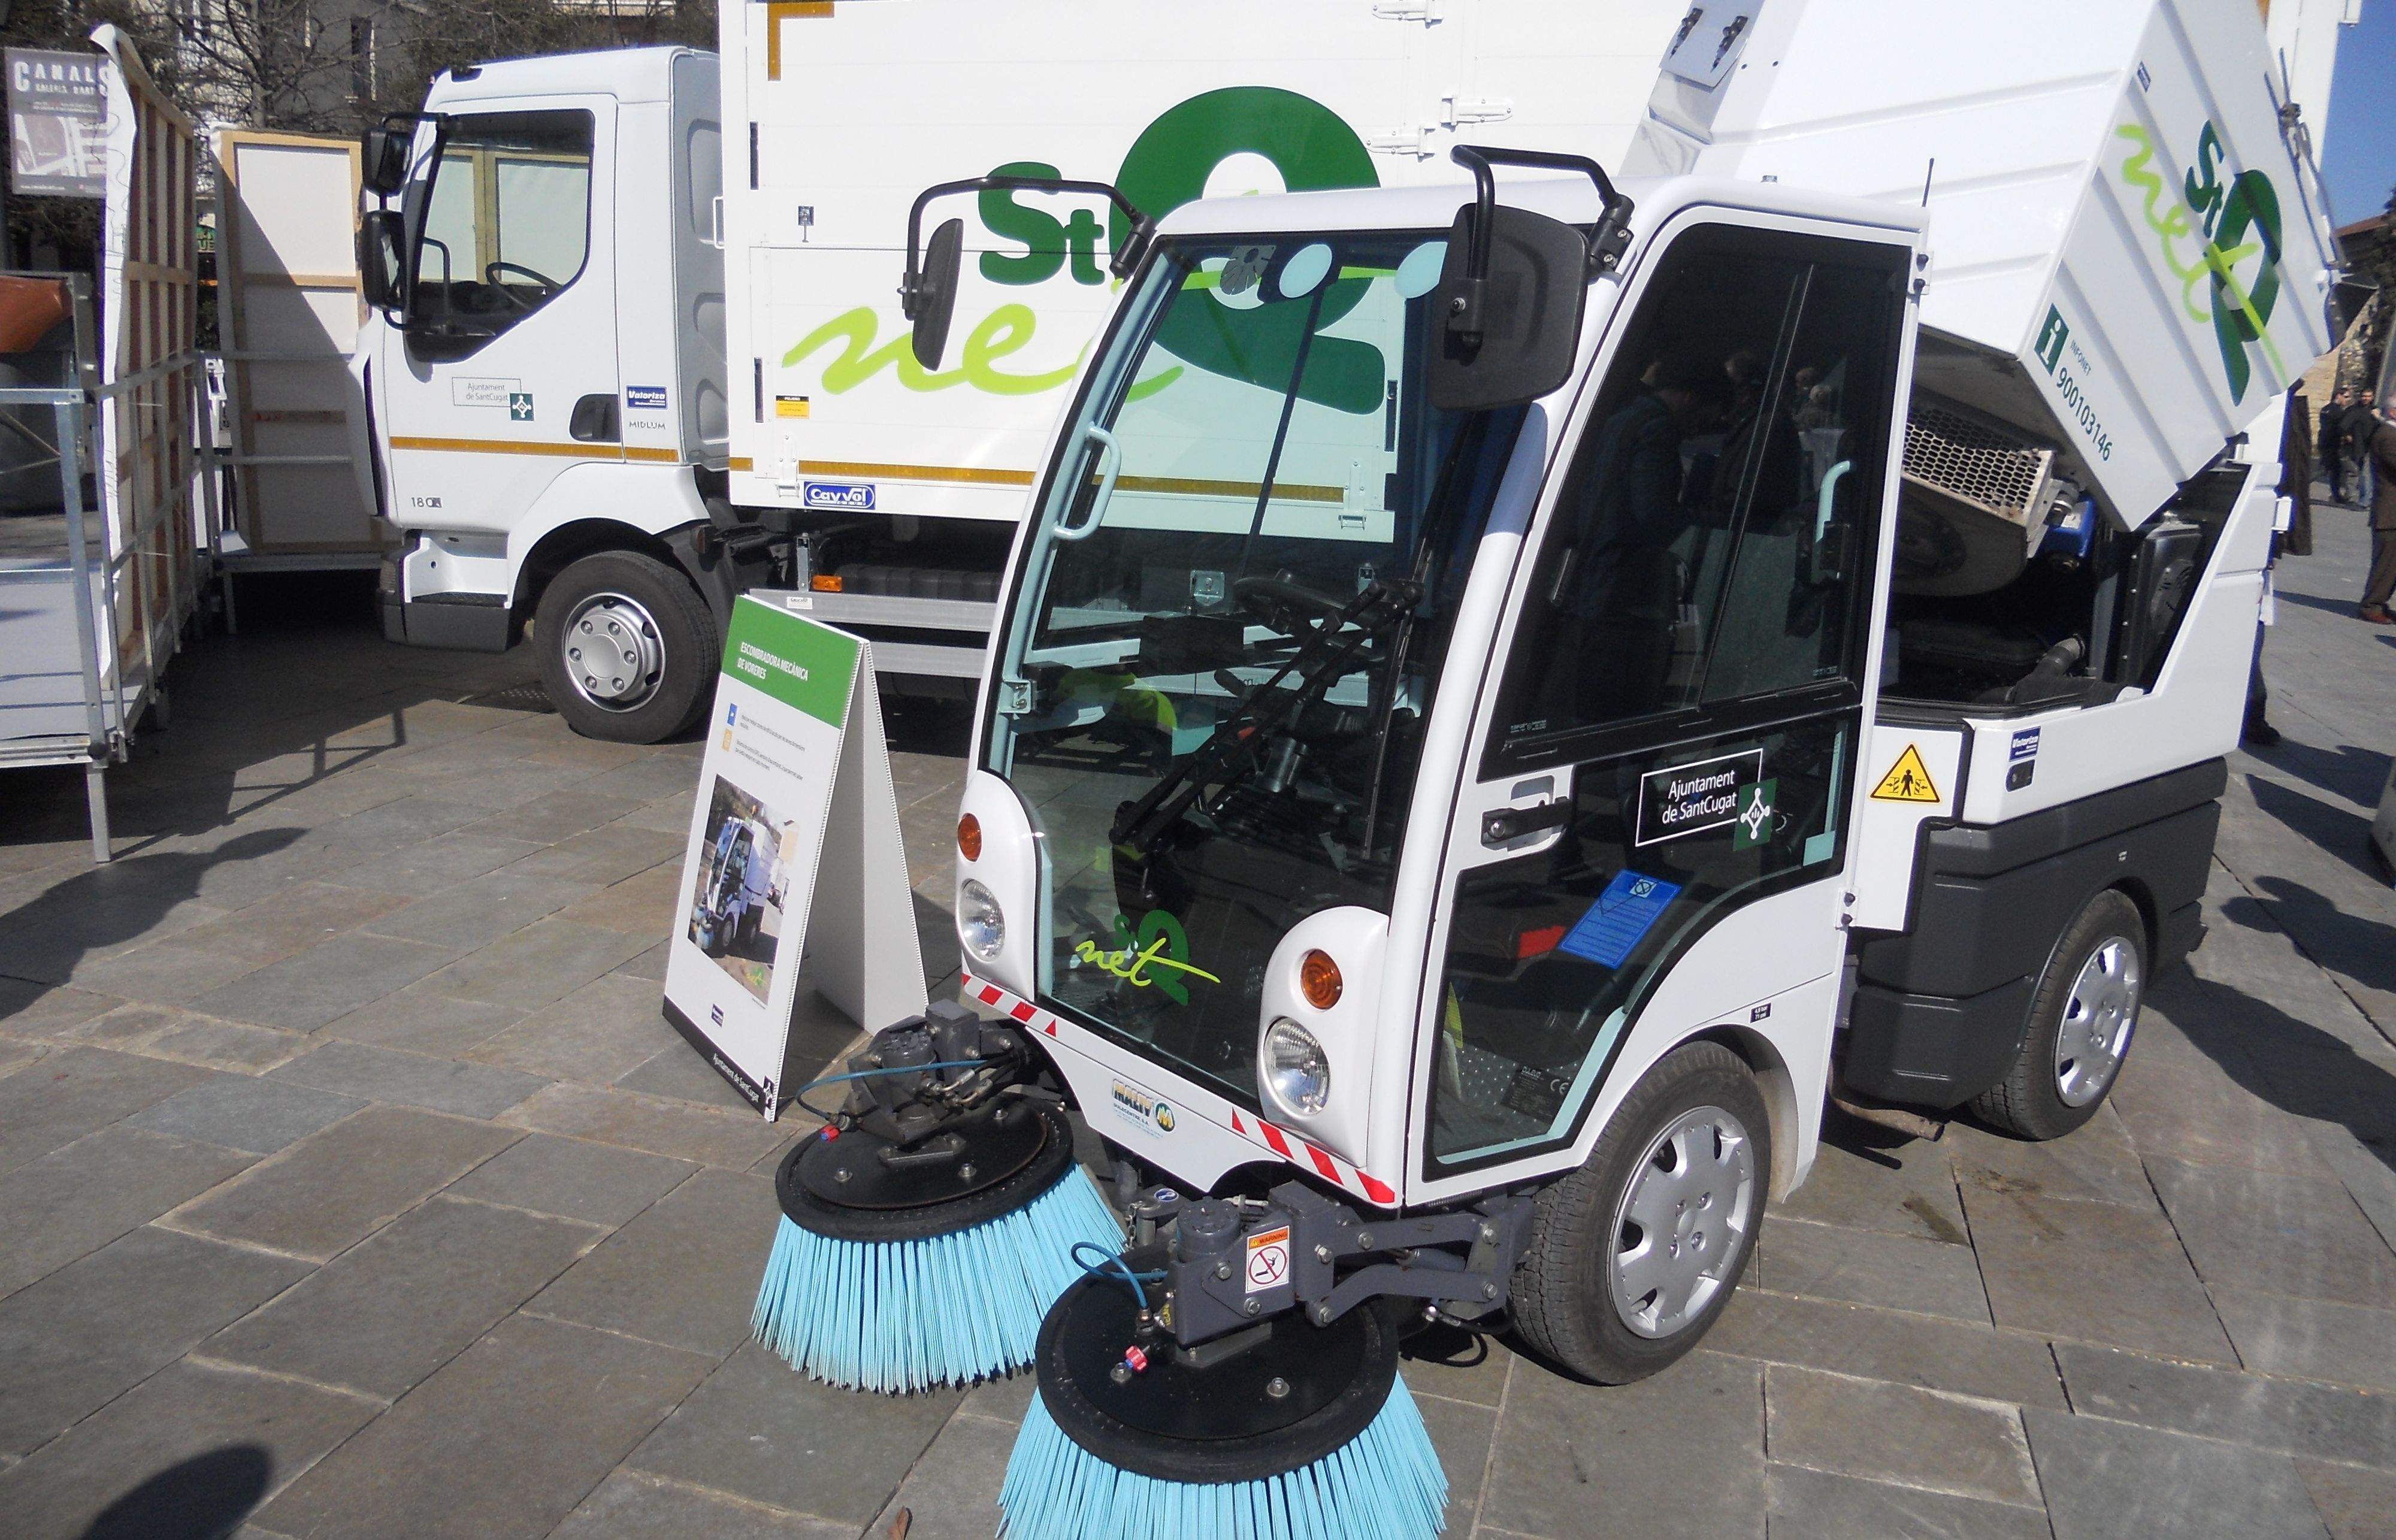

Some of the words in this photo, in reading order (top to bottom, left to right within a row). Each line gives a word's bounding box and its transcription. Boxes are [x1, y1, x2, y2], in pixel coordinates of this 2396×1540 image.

[2070, 339, 2092, 376] INFONET
[468, 383, 506, 392] Ajuntament
[476, 394, 509, 402] SantCugat
[628, 391, 665, 400] Valoriza
[629, 420, 665, 429] MIDLUM
[2056, 367, 2113, 461] 900103146
[737, 658, 746, 670] DE
[745, 660, 767, 680] VORERES
[740, 642, 780, 668] ESCOMBRADORA
[780, 659, 809, 681] MECÀNICA
[1668, 770, 1735, 803] Ajuntament
[1662, 805, 1678, 824] de
[1679, 792, 1737, 820] SantCugat
[1075, 937, 1221, 987] net
